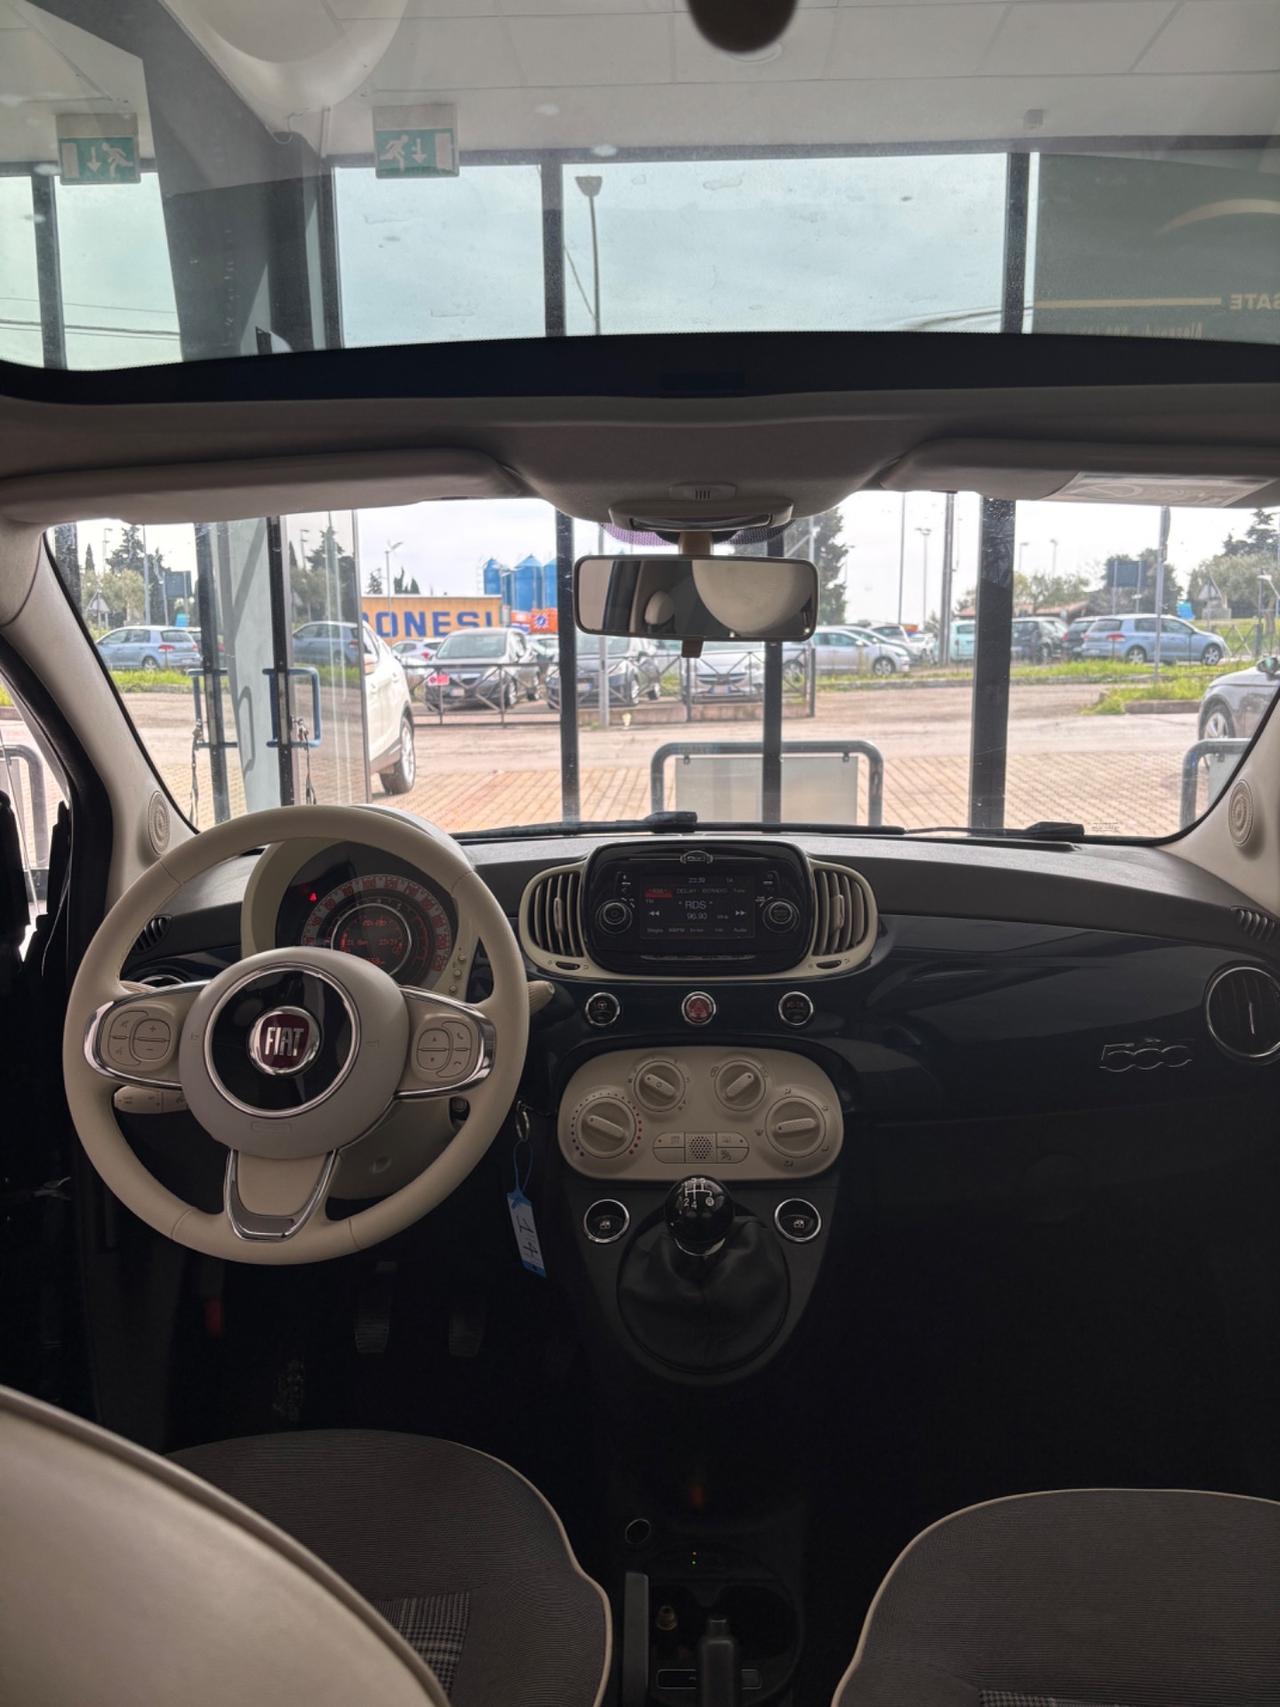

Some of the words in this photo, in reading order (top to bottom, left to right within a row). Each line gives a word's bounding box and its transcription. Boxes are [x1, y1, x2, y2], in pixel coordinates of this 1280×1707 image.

[361, 611, 492, 638] ONESI
[265, 1027, 304, 1057] FIAT
[1099, 1043, 1193, 1073] 500
